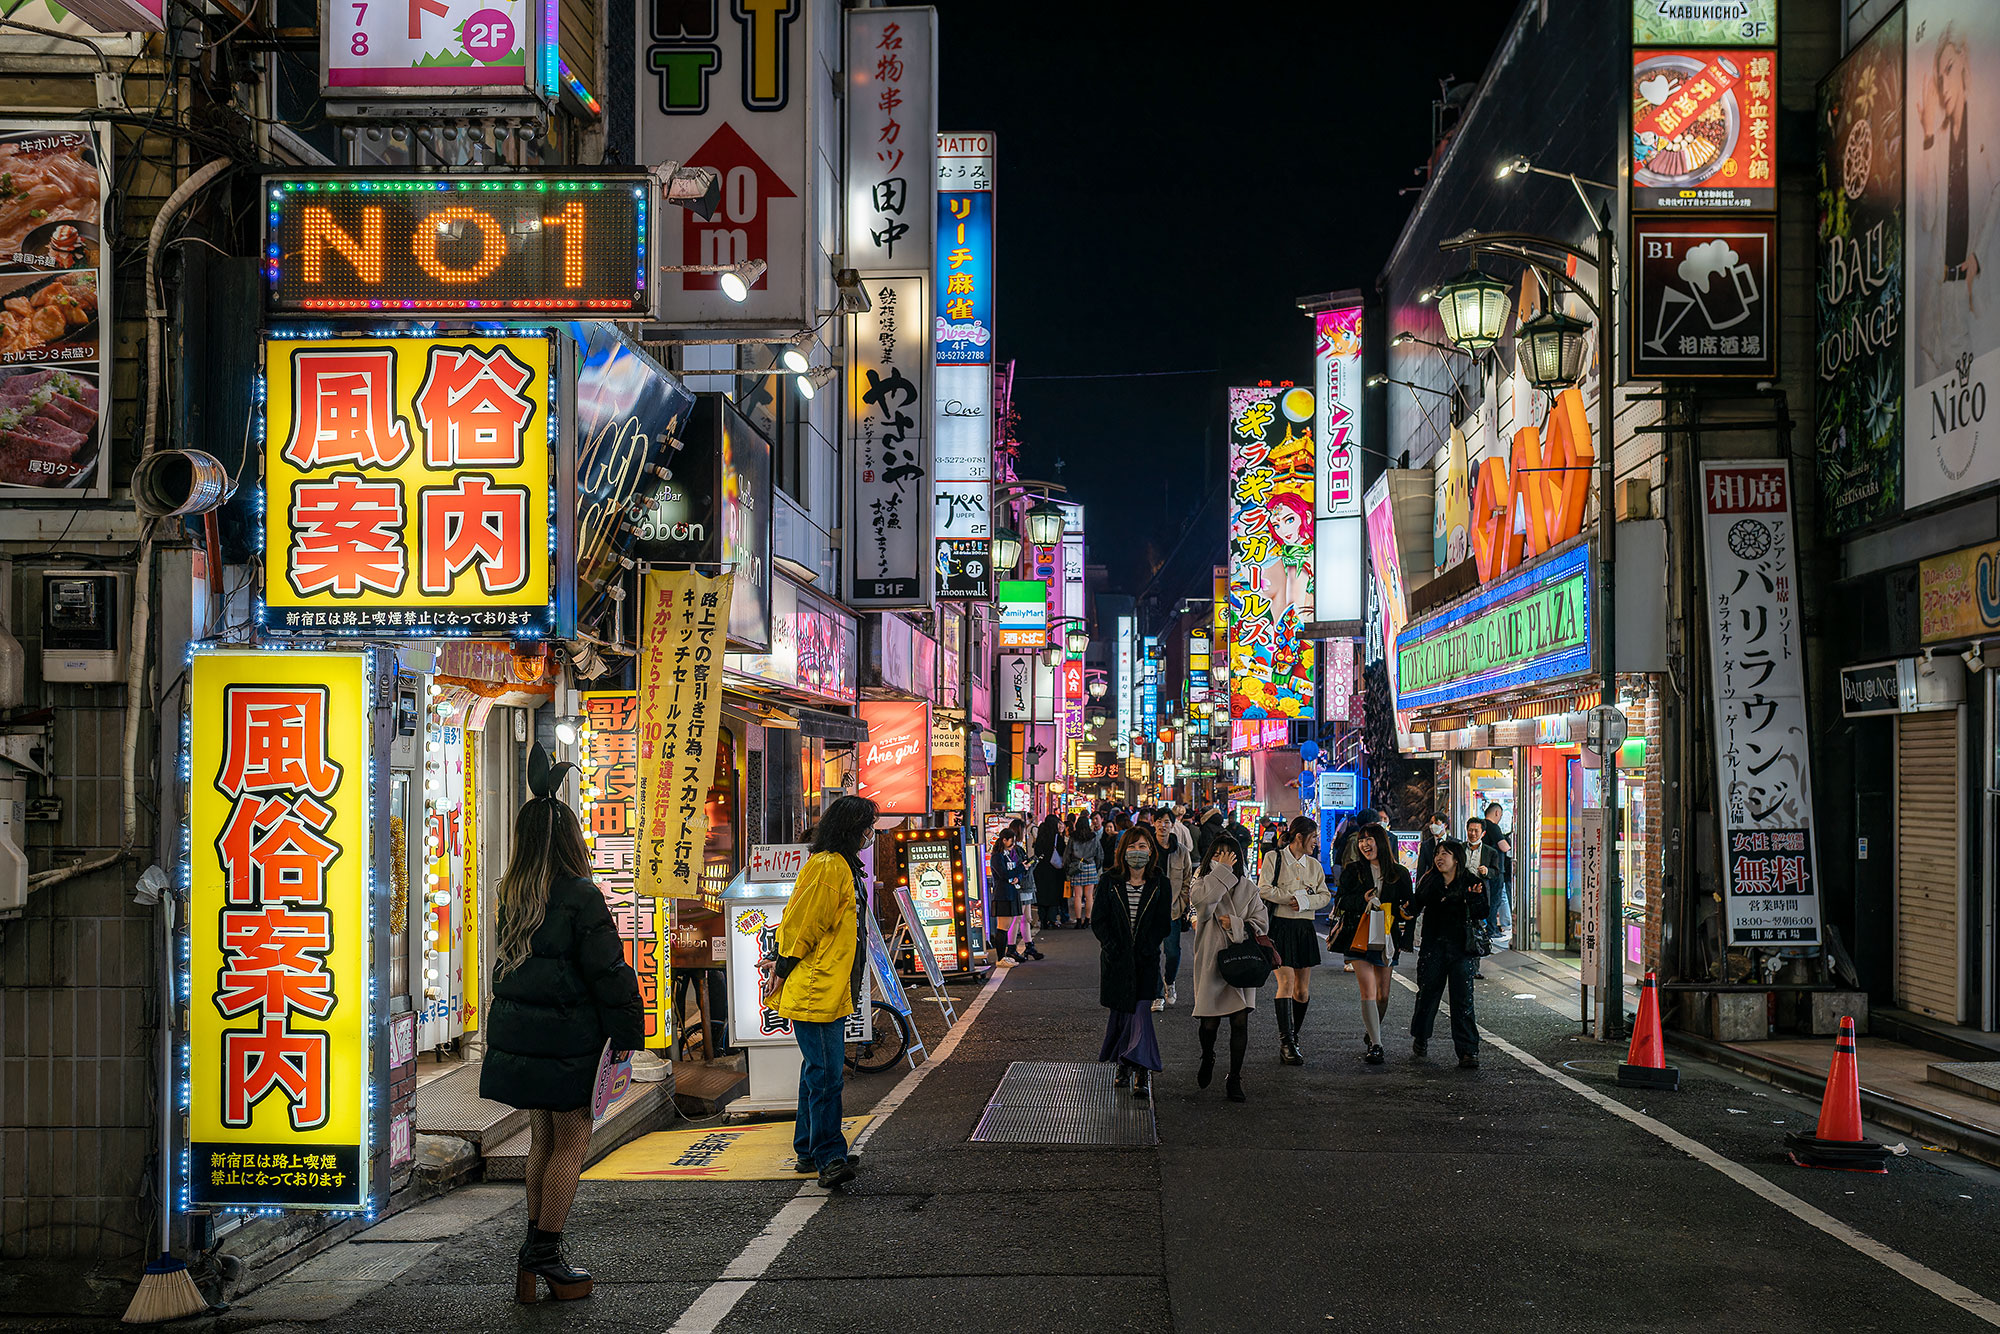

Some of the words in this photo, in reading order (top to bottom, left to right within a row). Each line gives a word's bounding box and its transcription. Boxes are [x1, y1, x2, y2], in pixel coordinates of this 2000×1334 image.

[1669, 6, 1739, 18] KABUKICHO
[470, 24, 507, 47] 2F
[1742, 23, 1766, 37] 3F
[875, 21, 904, 173] 名物串カツ
[20, 133, 86, 153] 牛ホルモン
[939, 166, 986, 178] おうみ
[973, 181, 989, 189] 5F
[869, 177, 910, 259] 田中
[946, 199, 975, 320] リーチ麻雀
[1647, 242, 1674, 259] B1
[1827, 219, 1890, 305] BALI
[952, 342, 969, 350] 4F
[1678, 335, 1761, 355] 相席酒場
[1821, 299, 1898, 381] LOUNGE
[937, 351, 985, 360] 03-5273-2788
[280, 345, 537, 472] 風俗
[943, 399, 983, 416] One
[1931, 380, 1986, 439] Nico
[27, 459, 82, 477] 厚切タン
[969, 467, 986, 476] 3F
[1710, 473, 1783, 509] 相席
[971, 525, 987, 533] 2F
[1235, 401, 1275, 647] ギラギラガールズ
[285, 471, 531, 598] 案内
[1772, 520, 1787, 572] アジアン
[968, 565, 981, 574] 2F
[874, 583, 904, 595] B1F
[1775, 576, 1790, 603] 相席
[286, 610, 532, 627] 新宿区は路上喫煙禁止になっております
[1003, 632, 1044, 644] 酒・たばこ
[1425, 631, 1468, 682] CATCHER
[1470, 633, 1485, 662] AND
[1486, 610, 1522, 664] GAME
[1527, 586, 1577, 652] PLAZA
[1779, 606, 1792, 660] リゾート
[1731, 561, 1789, 822] バリラウンジ
[866, 745, 894, 766] Ane
[893, 740, 920, 765] girl
[1732, 832, 1770, 852] 女性
[753, 850, 801, 872] キャバクラ
[1733, 856, 1810, 894] 無料
[925, 889, 939, 898] 55
[213, 683, 343, 1129] 風俗案内
[1748, 900, 1798, 911] 営業時間
[211, 1152, 337, 1169] 新宿区は路上喫煙
[211, 1170, 347, 1189] 禁止になっております
